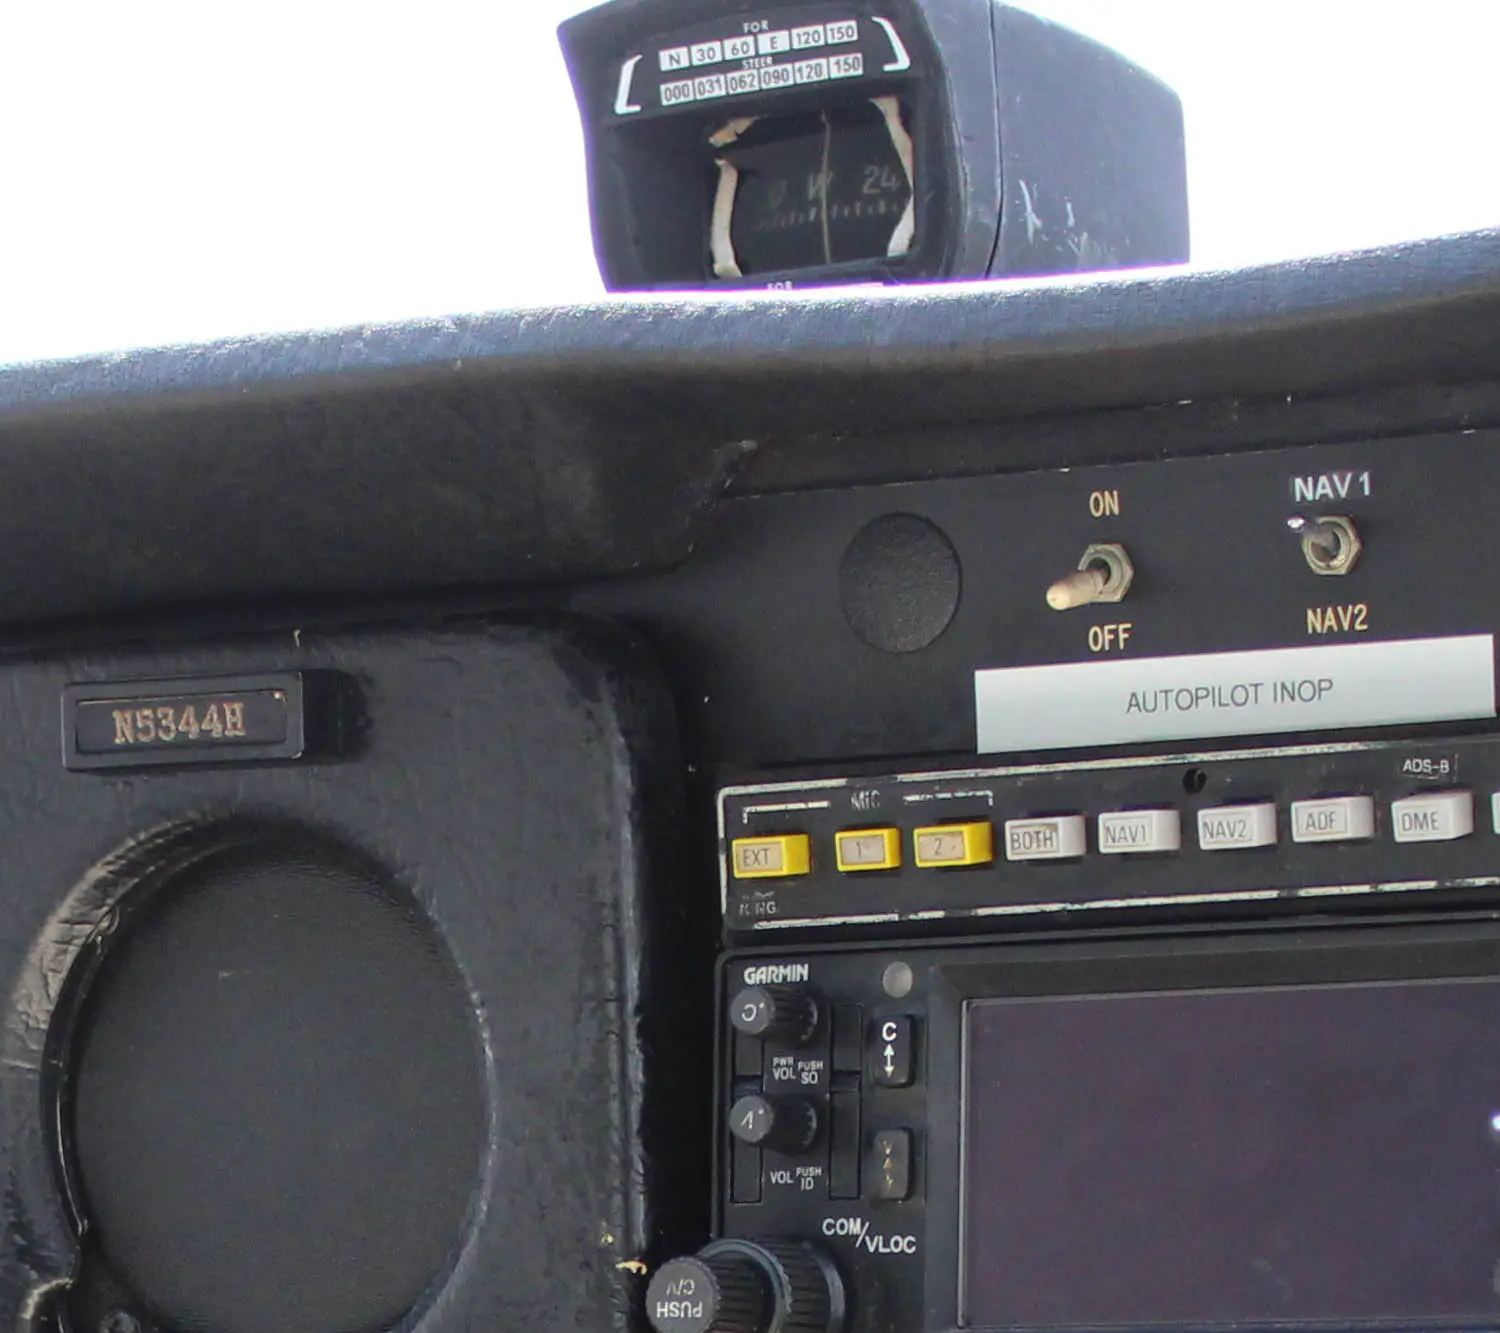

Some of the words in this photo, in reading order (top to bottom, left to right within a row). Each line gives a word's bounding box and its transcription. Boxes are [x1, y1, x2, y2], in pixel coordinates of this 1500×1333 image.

[696, 47, 715, 62] 30
[731, 41, 749, 56] 60
[664, 85, 691, 102] 000
[697, 78, 723, 95] 031
[729, 73, 756, 90] 062
[763, 68, 789, 86] 090
[1294, 474, 1351, 503] NAV
[1090, 491, 1119, 517] ON
[1306, 605, 1368, 634] NAV2
[1088, 624, 1132, 652] OFF
[1126, 683, 1264, 714] AUTOPILOT
[1273, 679, 1333, 703] INOP
[1402, 758, 1450, 775] ADS-B
[1010, 829, 1056, 851] BOTH
[1105, 823, 1147, 845] NAV1
[1203, 820, 1247, 841] NAV2
[1305, 810, 1336, 832] ADF
[1402, 812, 1441, 833] DME
[744, 964, 809, 985] GARMIN
[656, 1300, 703, 1319] PUSH
